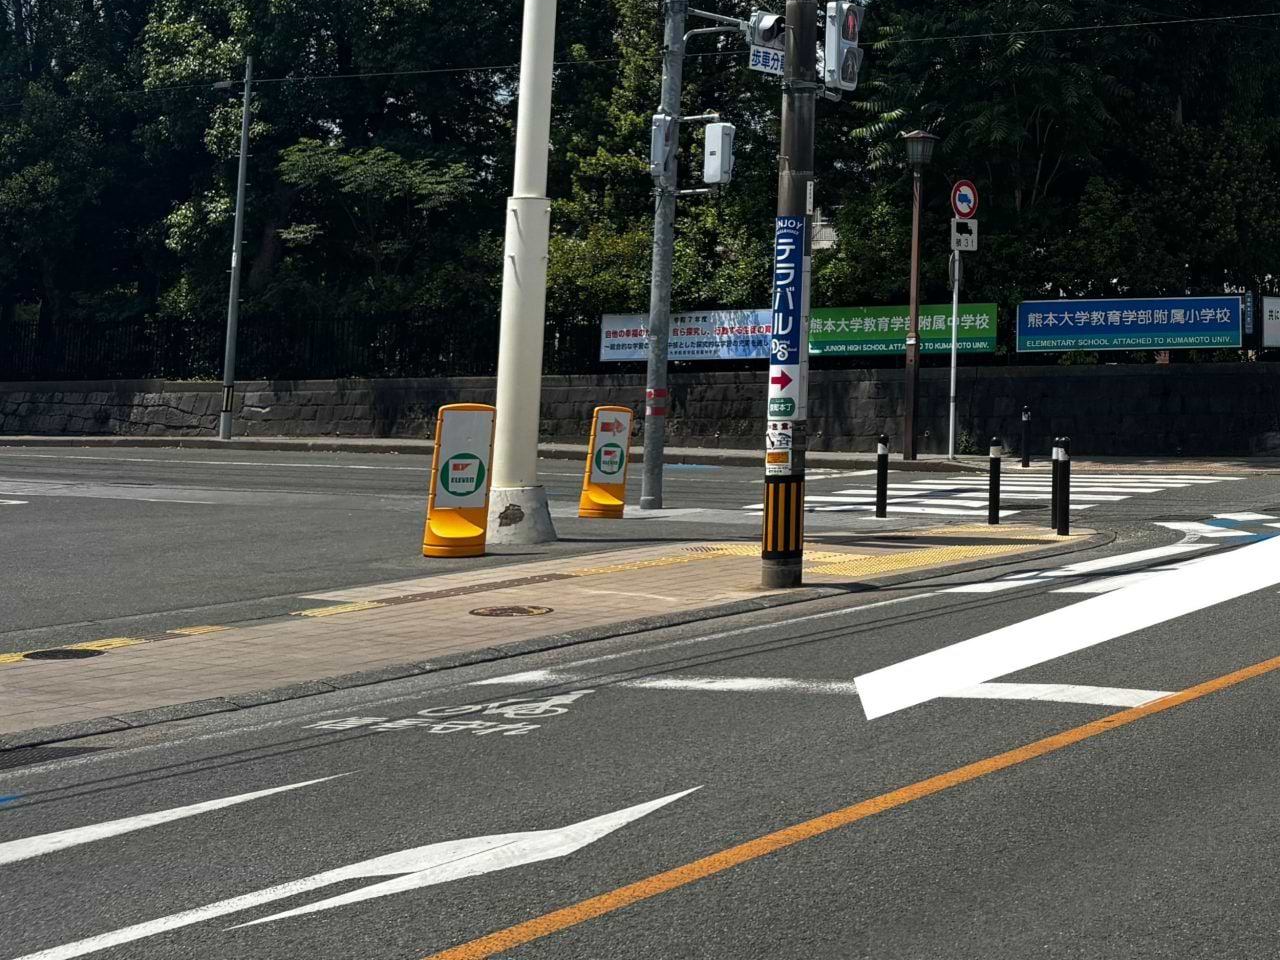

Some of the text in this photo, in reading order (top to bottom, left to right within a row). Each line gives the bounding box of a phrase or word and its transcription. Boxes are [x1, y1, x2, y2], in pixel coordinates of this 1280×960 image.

[773, 238, 796, 335] テラバル
[1027, 307, 1232, 328] 熊本大学教育学部附属小学校
[823, 343, 847, 352] JUNIOR
[847, 343, 863, 352] HIGH
[863, 343, 887, 351] SCHOOL
[935, 342, 971, 350] KUMAOTO
[1026, 335, 1233, 347] ELEMENTARY SCHOOL ATTACHED TO KUMAMOTO UNIV.
[302, 716, 542, 736] 信号守れ
